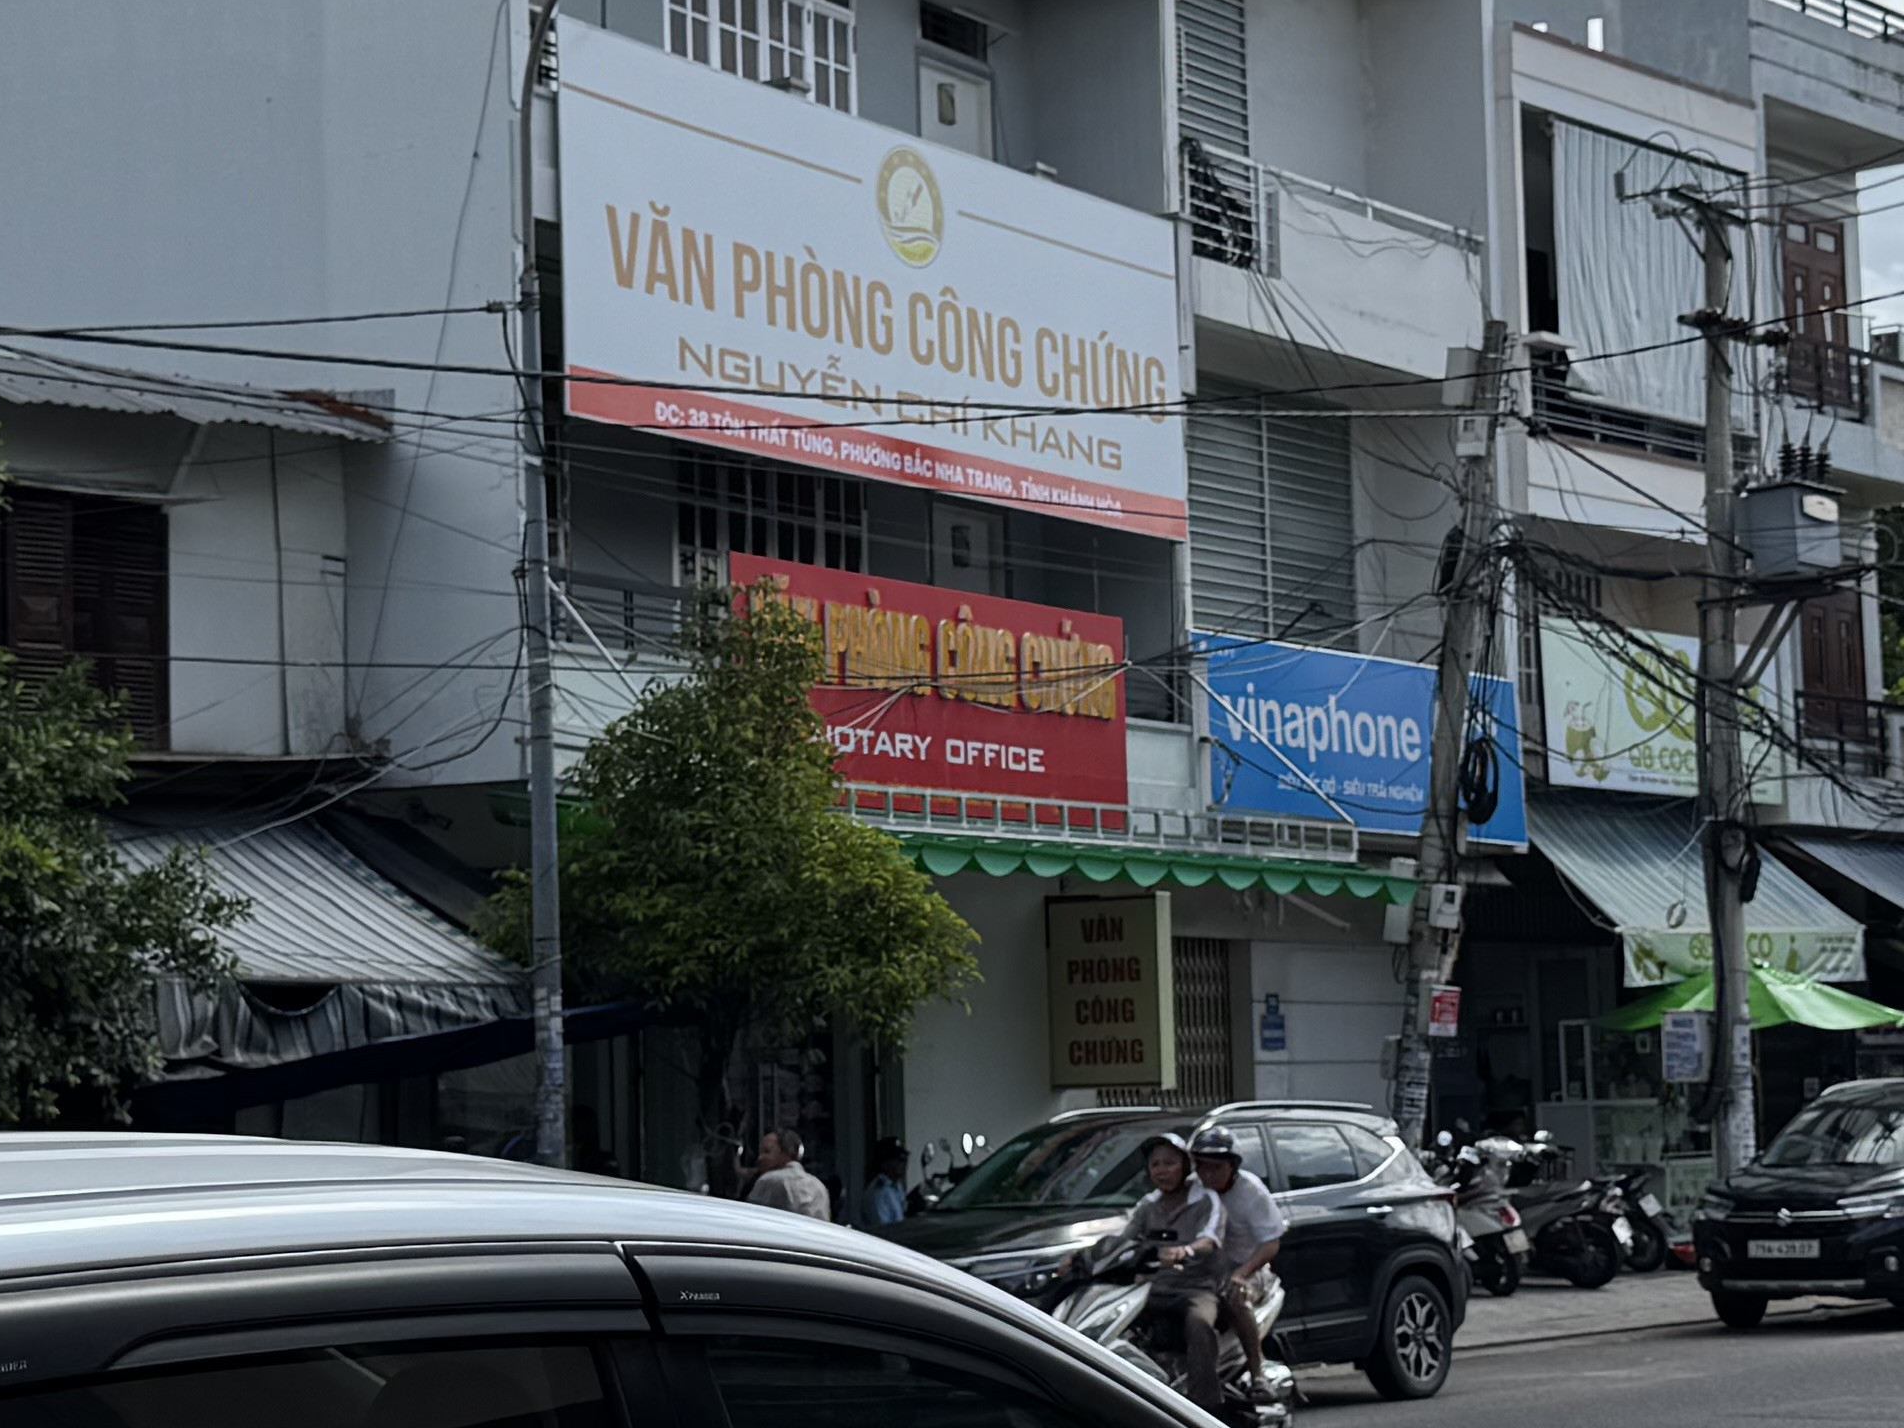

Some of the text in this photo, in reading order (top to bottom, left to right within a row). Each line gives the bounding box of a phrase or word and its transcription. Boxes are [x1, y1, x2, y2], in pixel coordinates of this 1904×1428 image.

[605, 200, 1167, 426] VĂN PHÒNG CÔNG CHỨNG
[678, 336, 1123, 471] NGUYỄN CHÍ KHANG
[945, 738, 1046, 773] OFFICE
[1220, 682, 1423, 763] vinaphone
